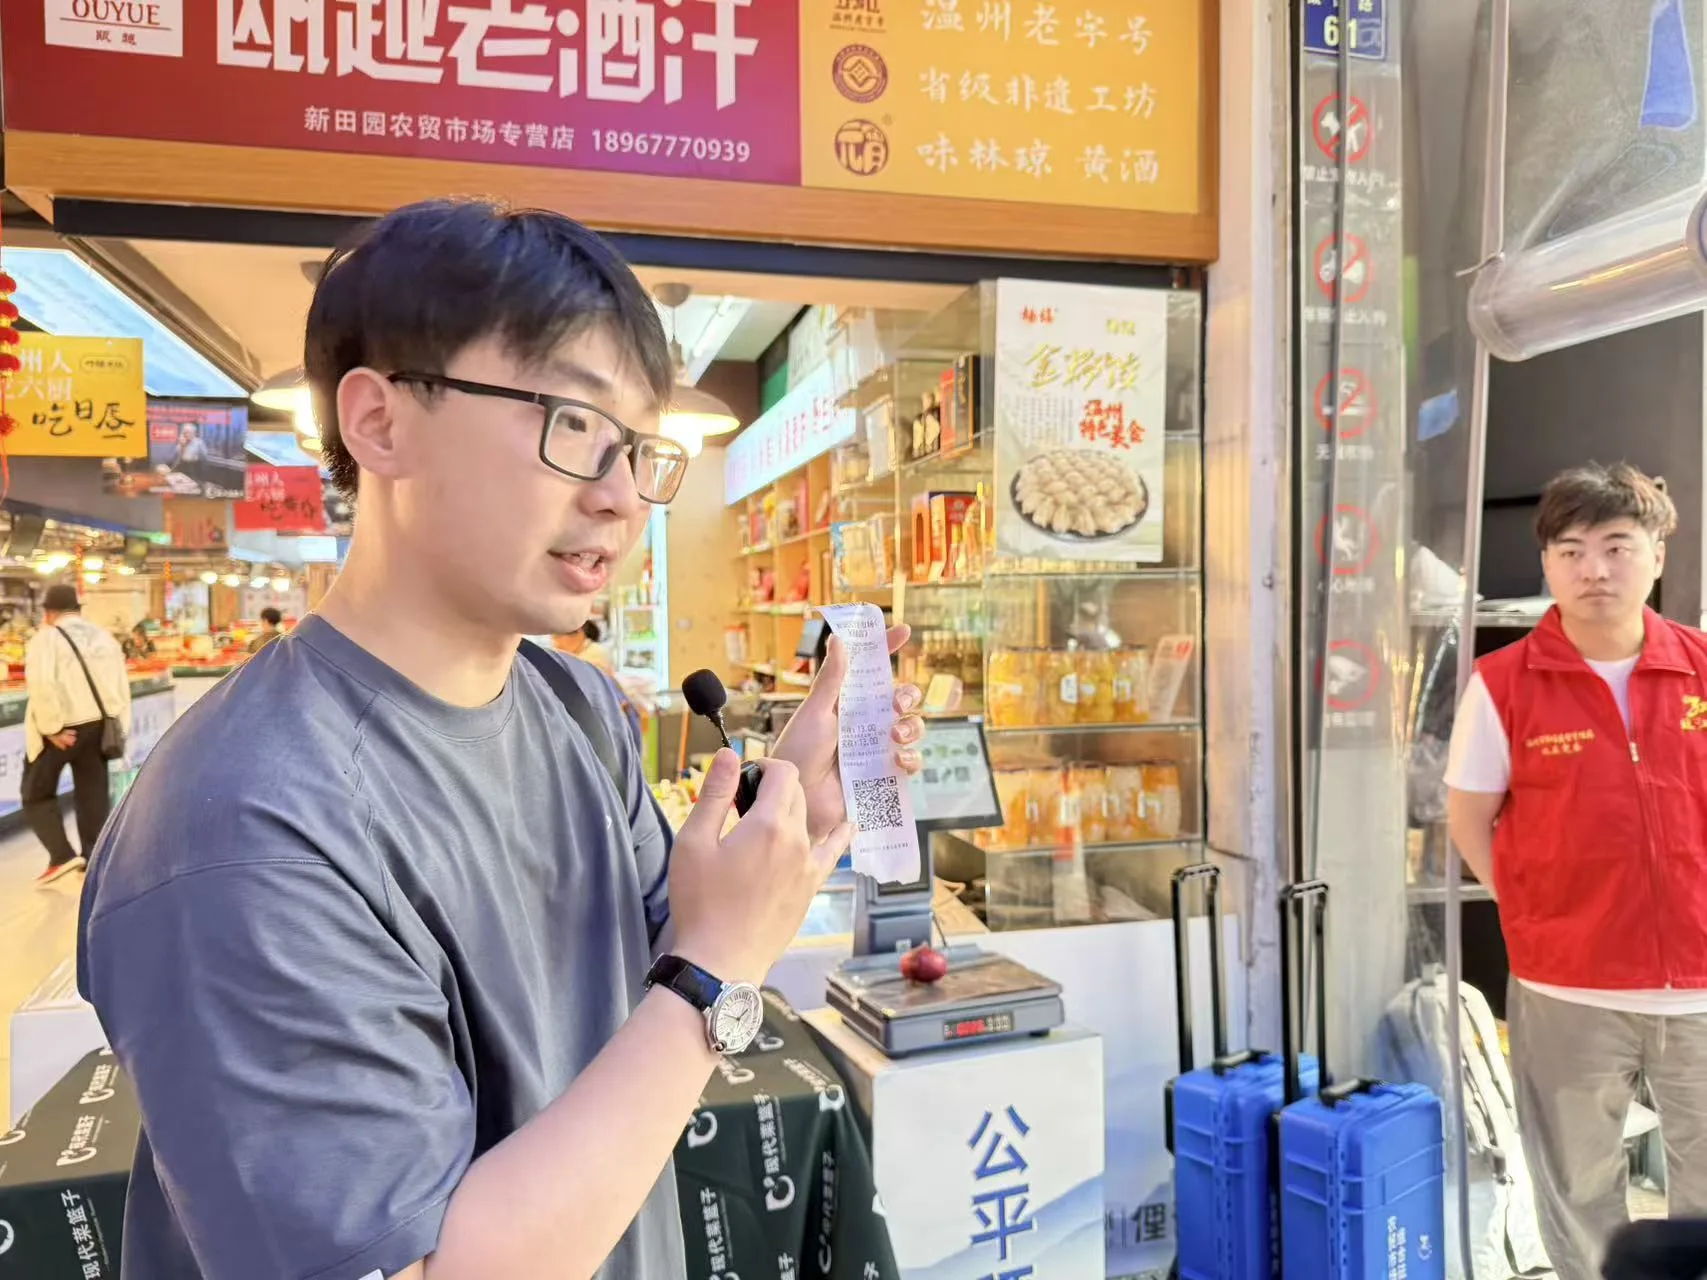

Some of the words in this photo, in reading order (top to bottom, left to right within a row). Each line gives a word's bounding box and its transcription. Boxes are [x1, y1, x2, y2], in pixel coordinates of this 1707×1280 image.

[72, 0, 161, 25] OUYUE
[920, 0, 1153, 55] 温州老字号
[919, 66, 1158, 120] 省级非遗工坊
[303, 105, 575, 151] 新田园农贸市场专营店
[592, 128, 751, 163] 18967770939
[1075, 143, 1160, 185] 黄酒
[60, 1188, 101, 1280] 现代菜篮子
